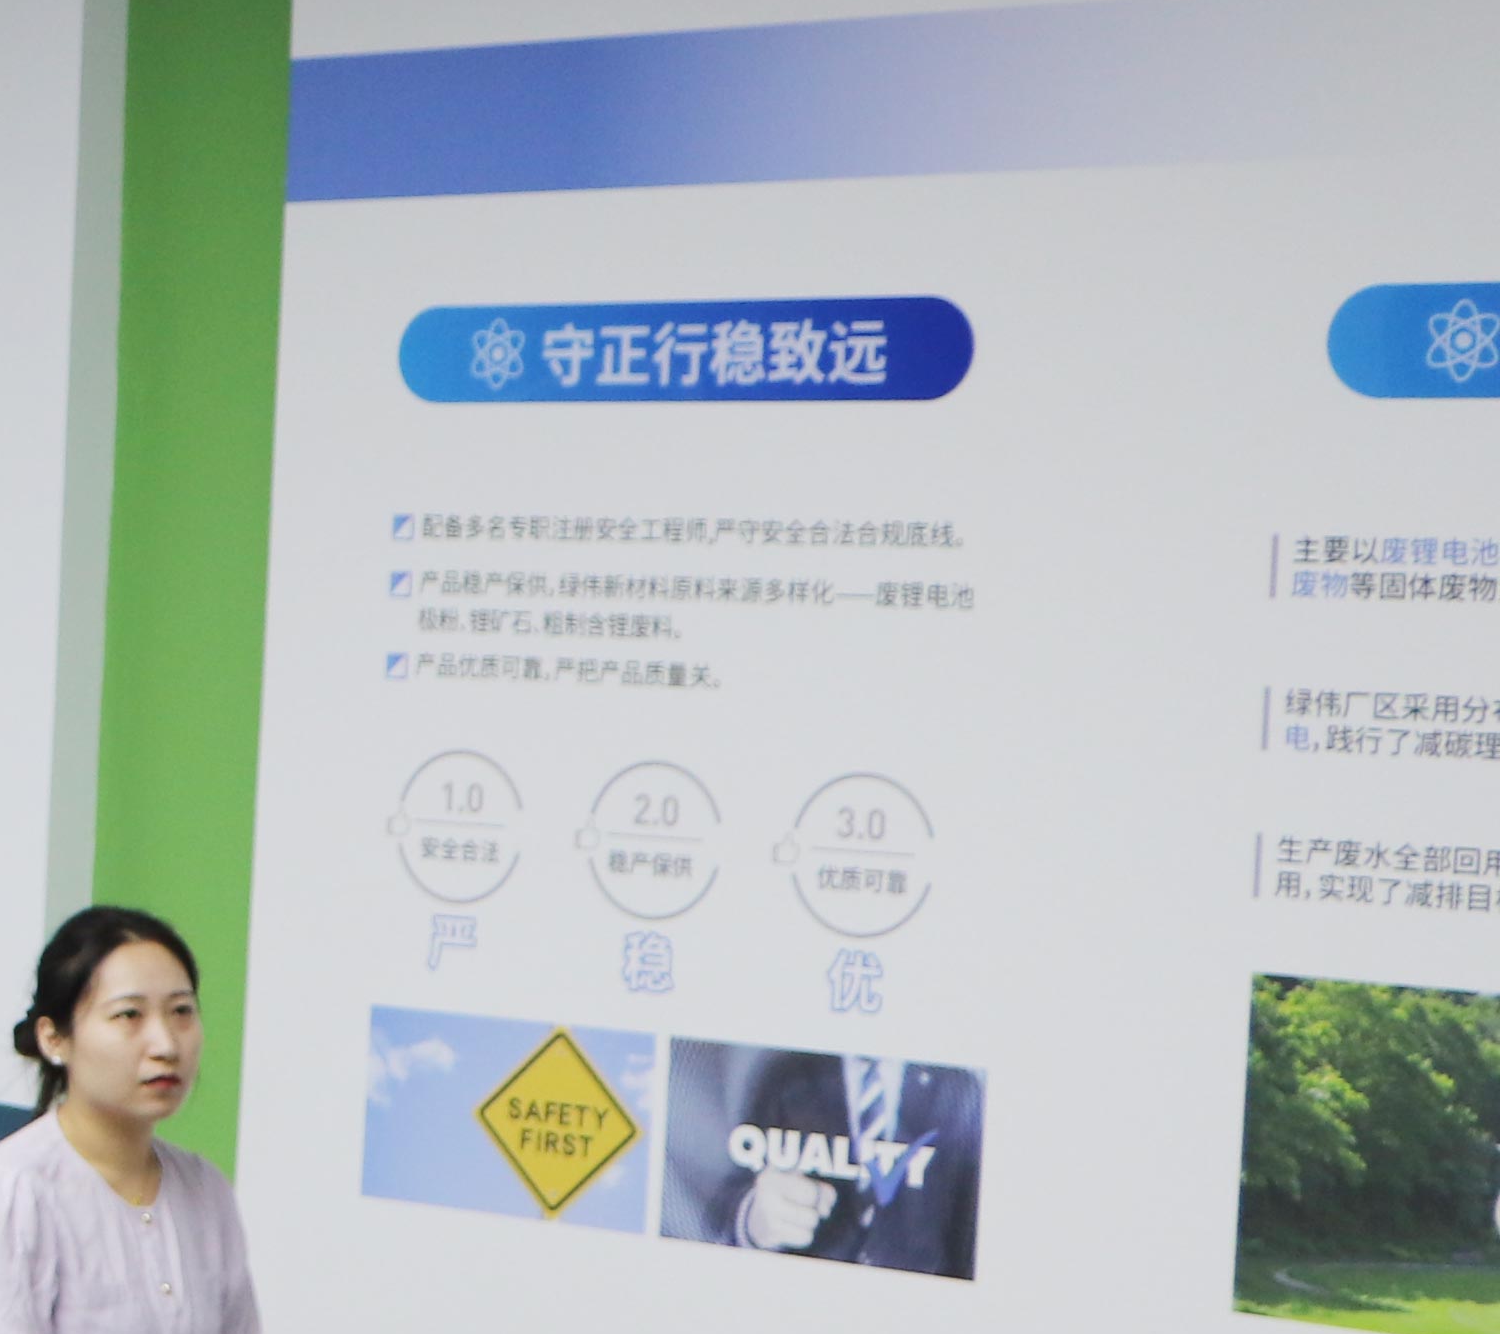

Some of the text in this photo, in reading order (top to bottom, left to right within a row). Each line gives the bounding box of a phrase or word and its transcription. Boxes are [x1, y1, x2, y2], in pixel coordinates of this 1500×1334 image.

[542, 318, 888, 387] 守正行稳致远
[1293, 535, 1499, 566] 主要以废锂电池
[443, 781, 485, 814] 1.0
[633, 793, 680, 828] 2.0
[837, 806, 887, 841] 3.0
[420, 836, 500, 863] 安全合法
[608, 849, 693, 878] 稳产保供
[817, 865, 908, 894] 优质可靠
[1275, 870, 1500, 912] 用，实现了减排目
[428, 914, 478, 972] 严
[621, 930, 676, 993] 稳
[827, 947, 884, 1014] 优
[507, 1096, 610, 1129] SAFETY
[520, 1128, 594, 1158] FIRST
[728, 1122, 936, 1189] QUALITY
